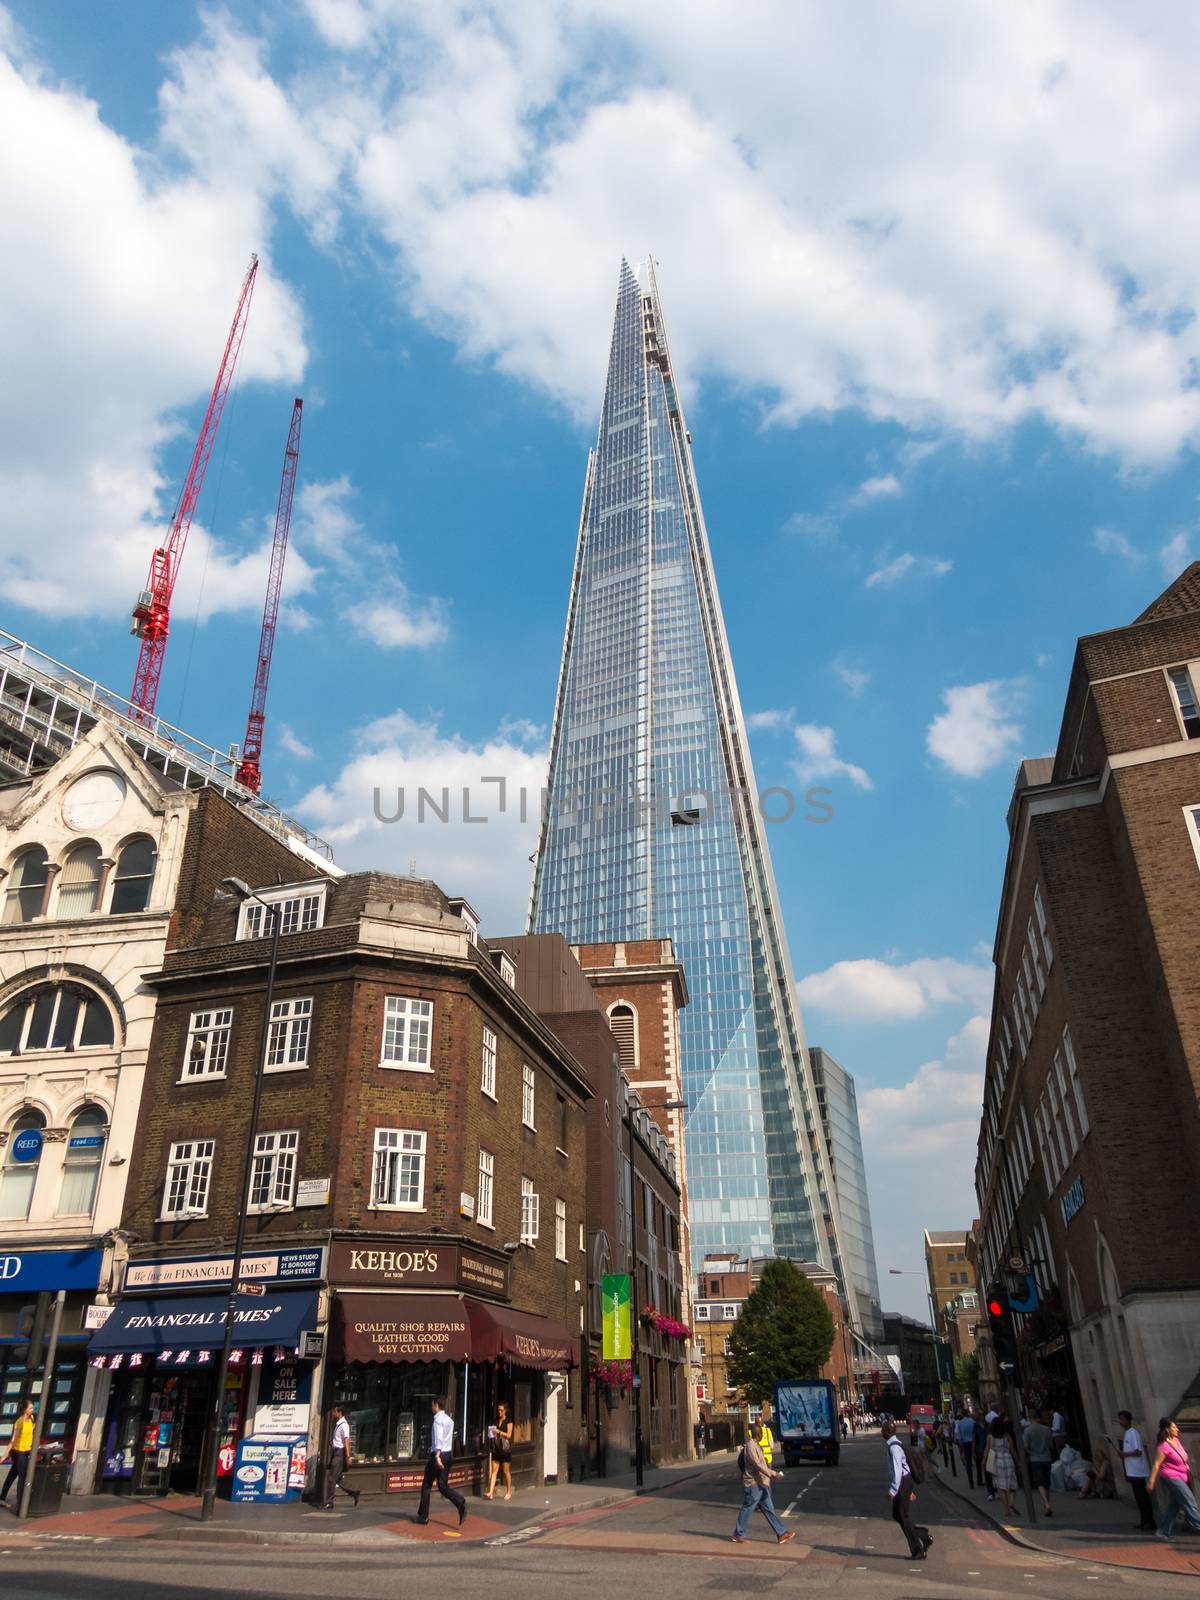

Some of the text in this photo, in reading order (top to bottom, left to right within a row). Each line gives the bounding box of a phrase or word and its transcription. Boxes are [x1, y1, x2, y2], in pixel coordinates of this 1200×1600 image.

[17, 1139, 39, 1149] REED
[298, 1253, 319, 1261] STUDIO
[350, 1249, 438, 1272] KEHOE'S
[288, 1260, 316, 1269] BOROUGH
[134, 1271, 146, 1282] We
[164, 1269, 173, 1279] in
[175, 1264, 232, 1279] FINANCIAL
[294, 1267, 316, 1275] STREET
[88, 1309, 108, 1319] BOOZE
[125, 1312, 215, 1328] FINANCIAL
[355, 1322, 465, 1333] QUALITY SHOE REPAIRS
[372, 1333, 450, 1343] LEATHER GOODS
[378, 1344, 444, 1354] KEY CUTTING
[279, 1367, 294, 1377] ON
[274, 1379, 297, 1389] SALE
[272, 1390, 297, 1401] HERE
